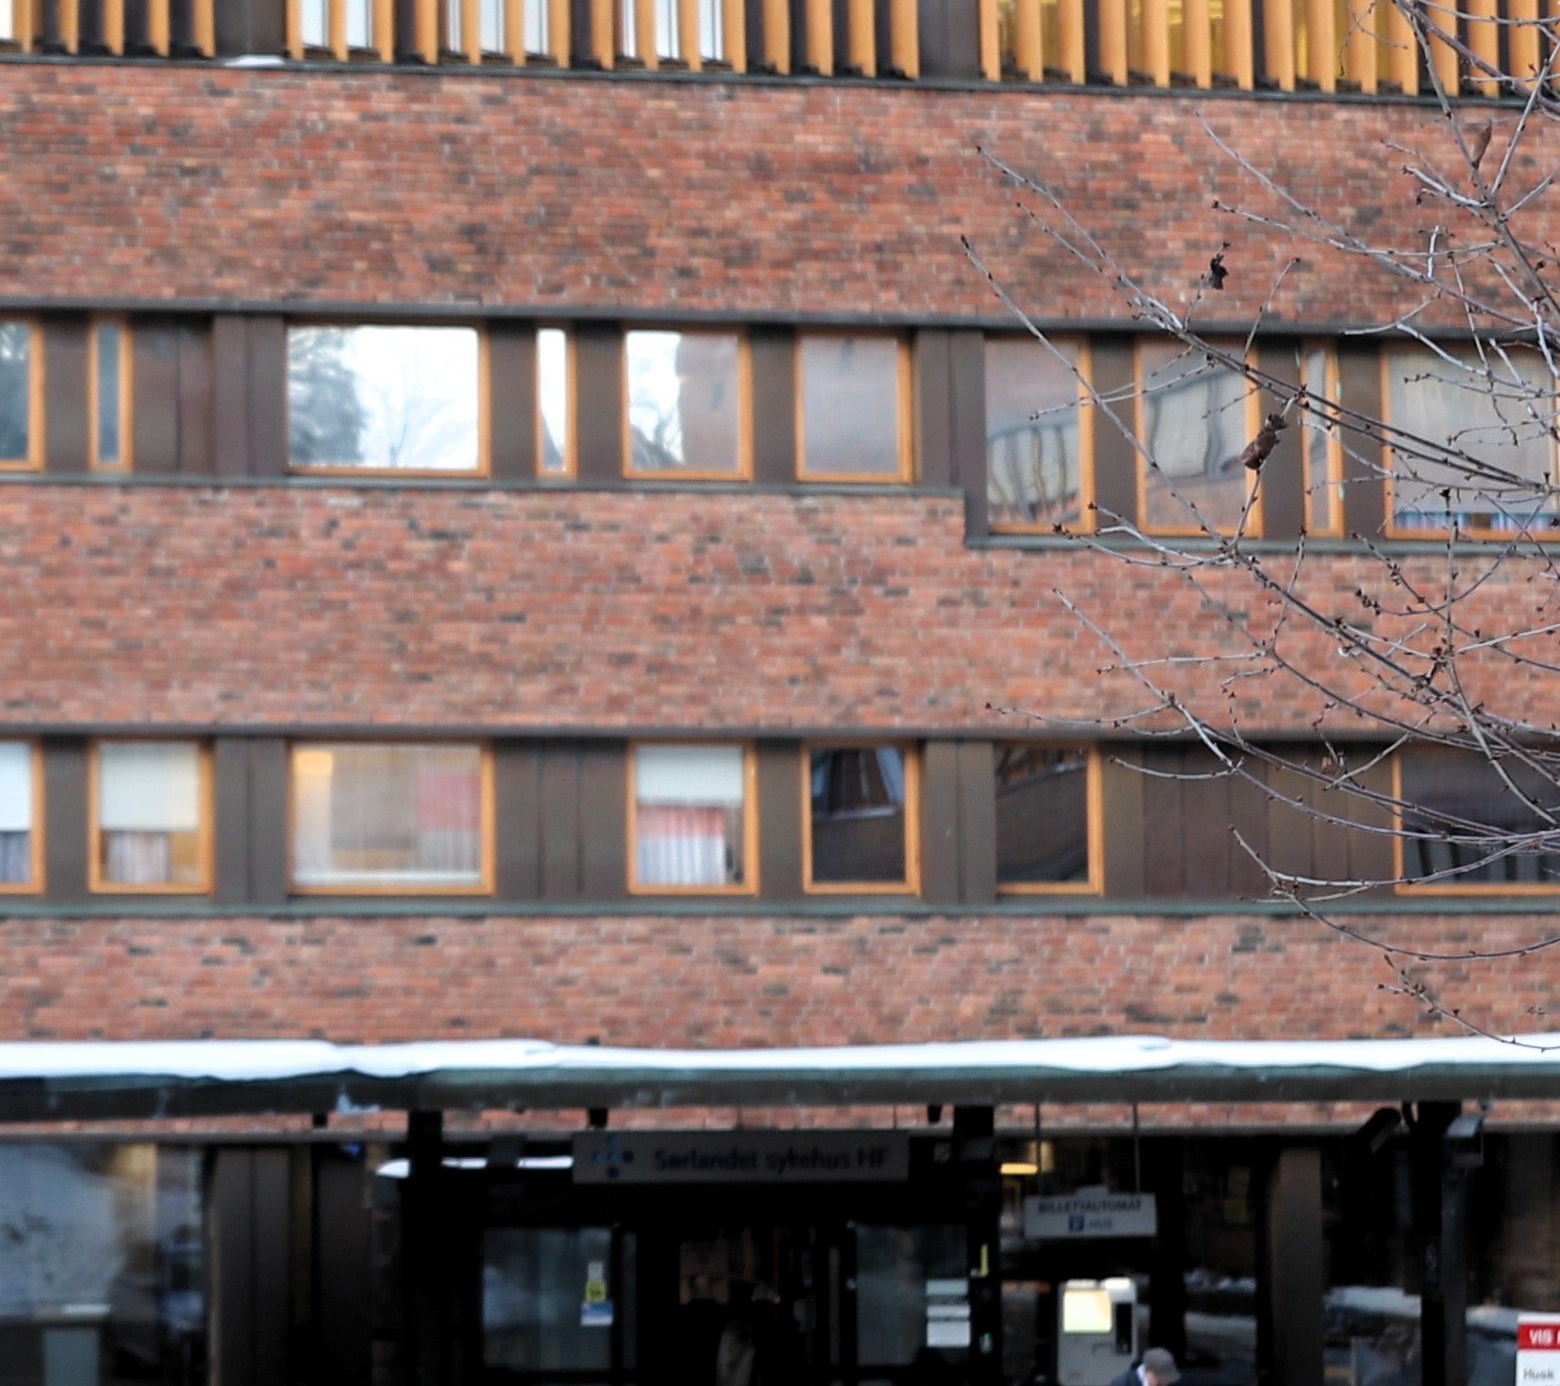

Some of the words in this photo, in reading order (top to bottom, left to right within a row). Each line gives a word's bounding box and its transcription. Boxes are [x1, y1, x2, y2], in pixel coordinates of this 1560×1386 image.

[653, 1146, 757, 1170] Sørlandet
[766, 1146, 851, 1177] sykehus
[858, 1147, 889, 1170] HF
[1529, 1328, 1552, 1347] VIS
[1523, 1366, 1554, 1380] Husk
